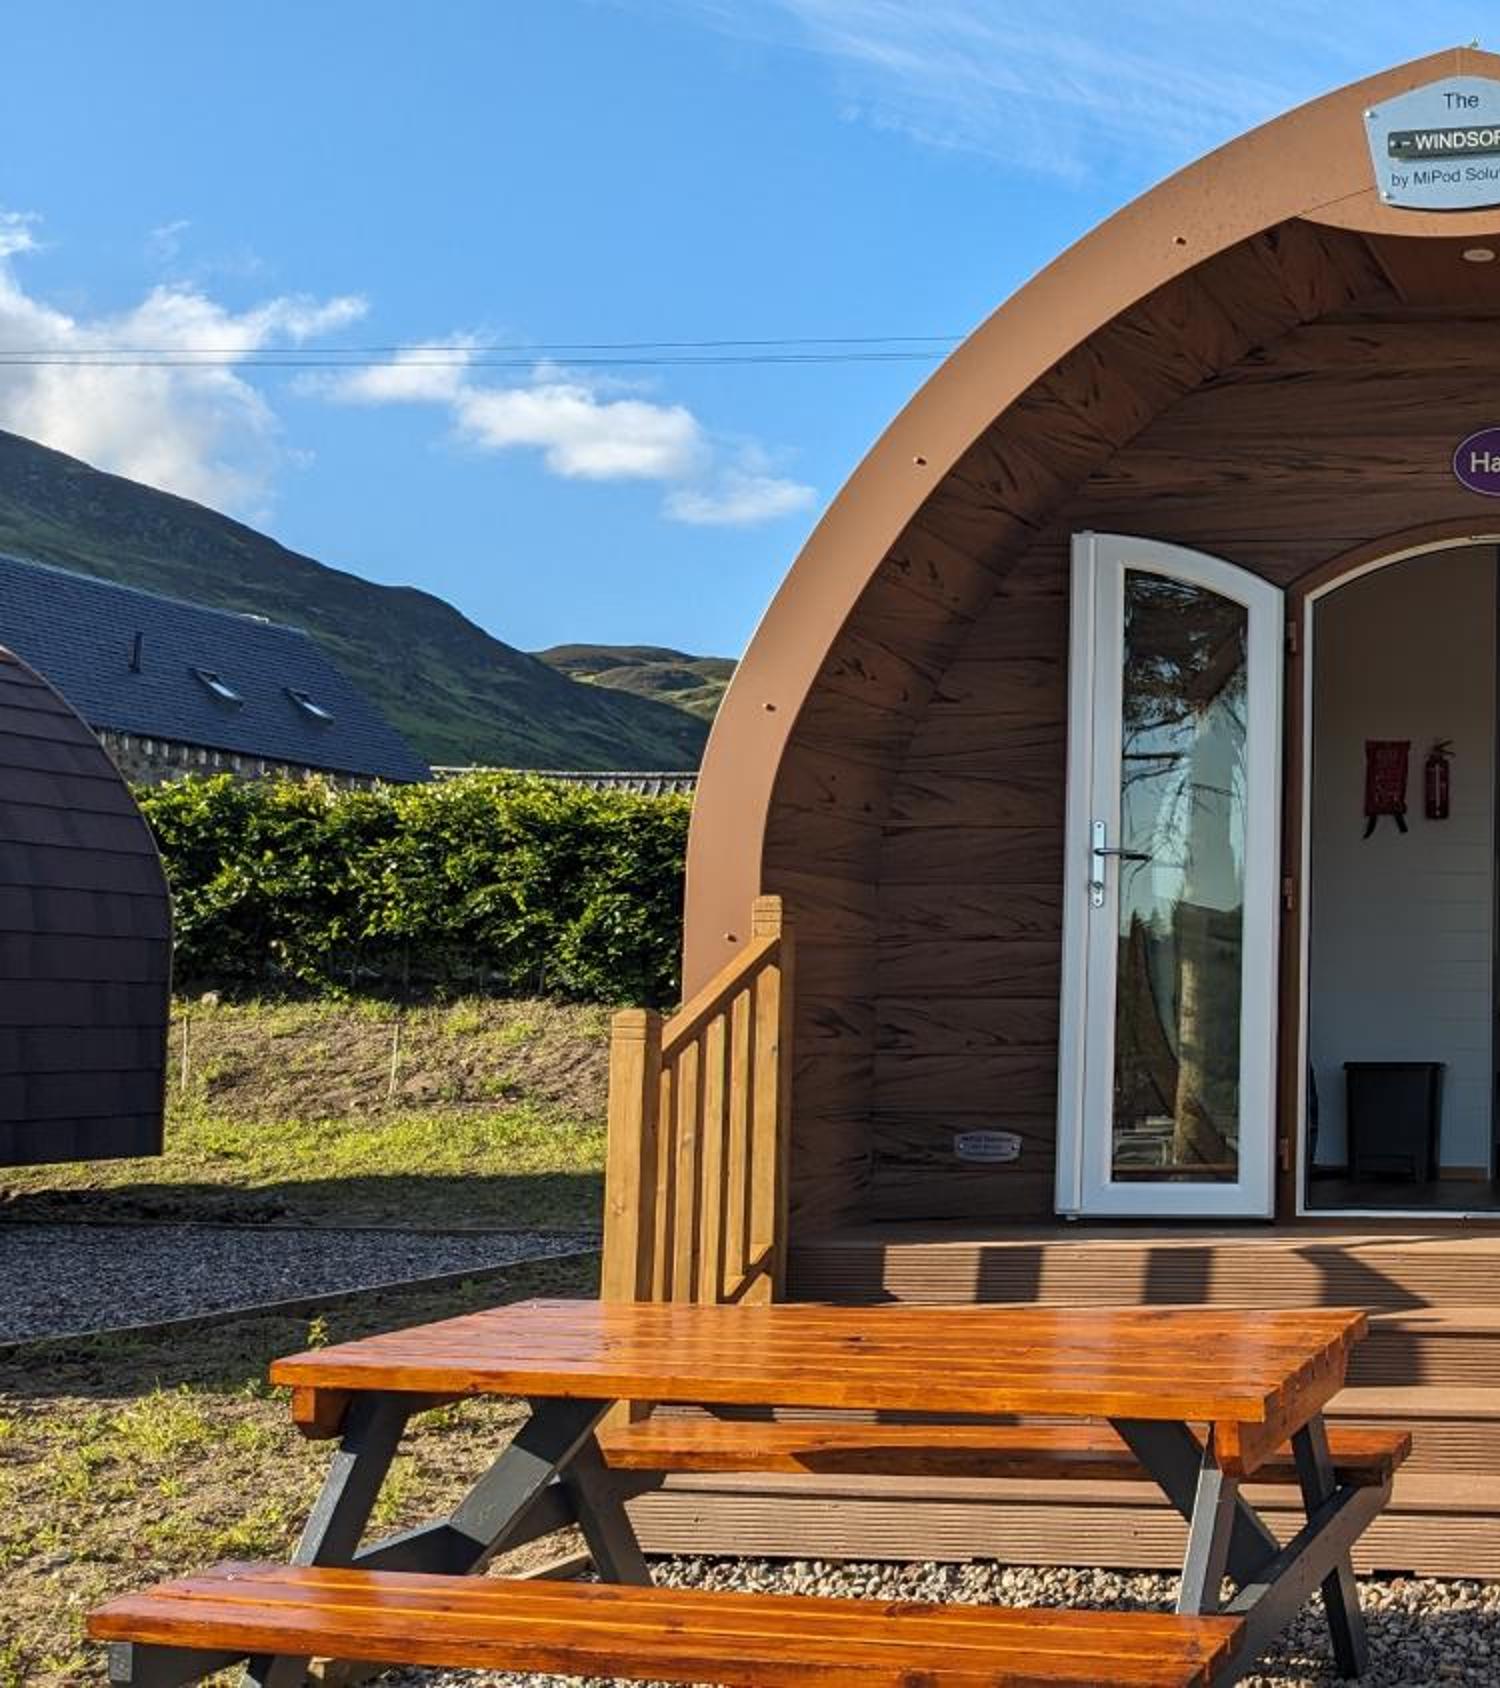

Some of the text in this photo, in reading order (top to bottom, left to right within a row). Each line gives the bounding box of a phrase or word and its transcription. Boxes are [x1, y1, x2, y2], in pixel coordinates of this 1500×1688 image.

[1444, 93, 1479, 109] The
[1391, 173, 1410, 189] by
[1413, 168, 1461, 185] MiPod
